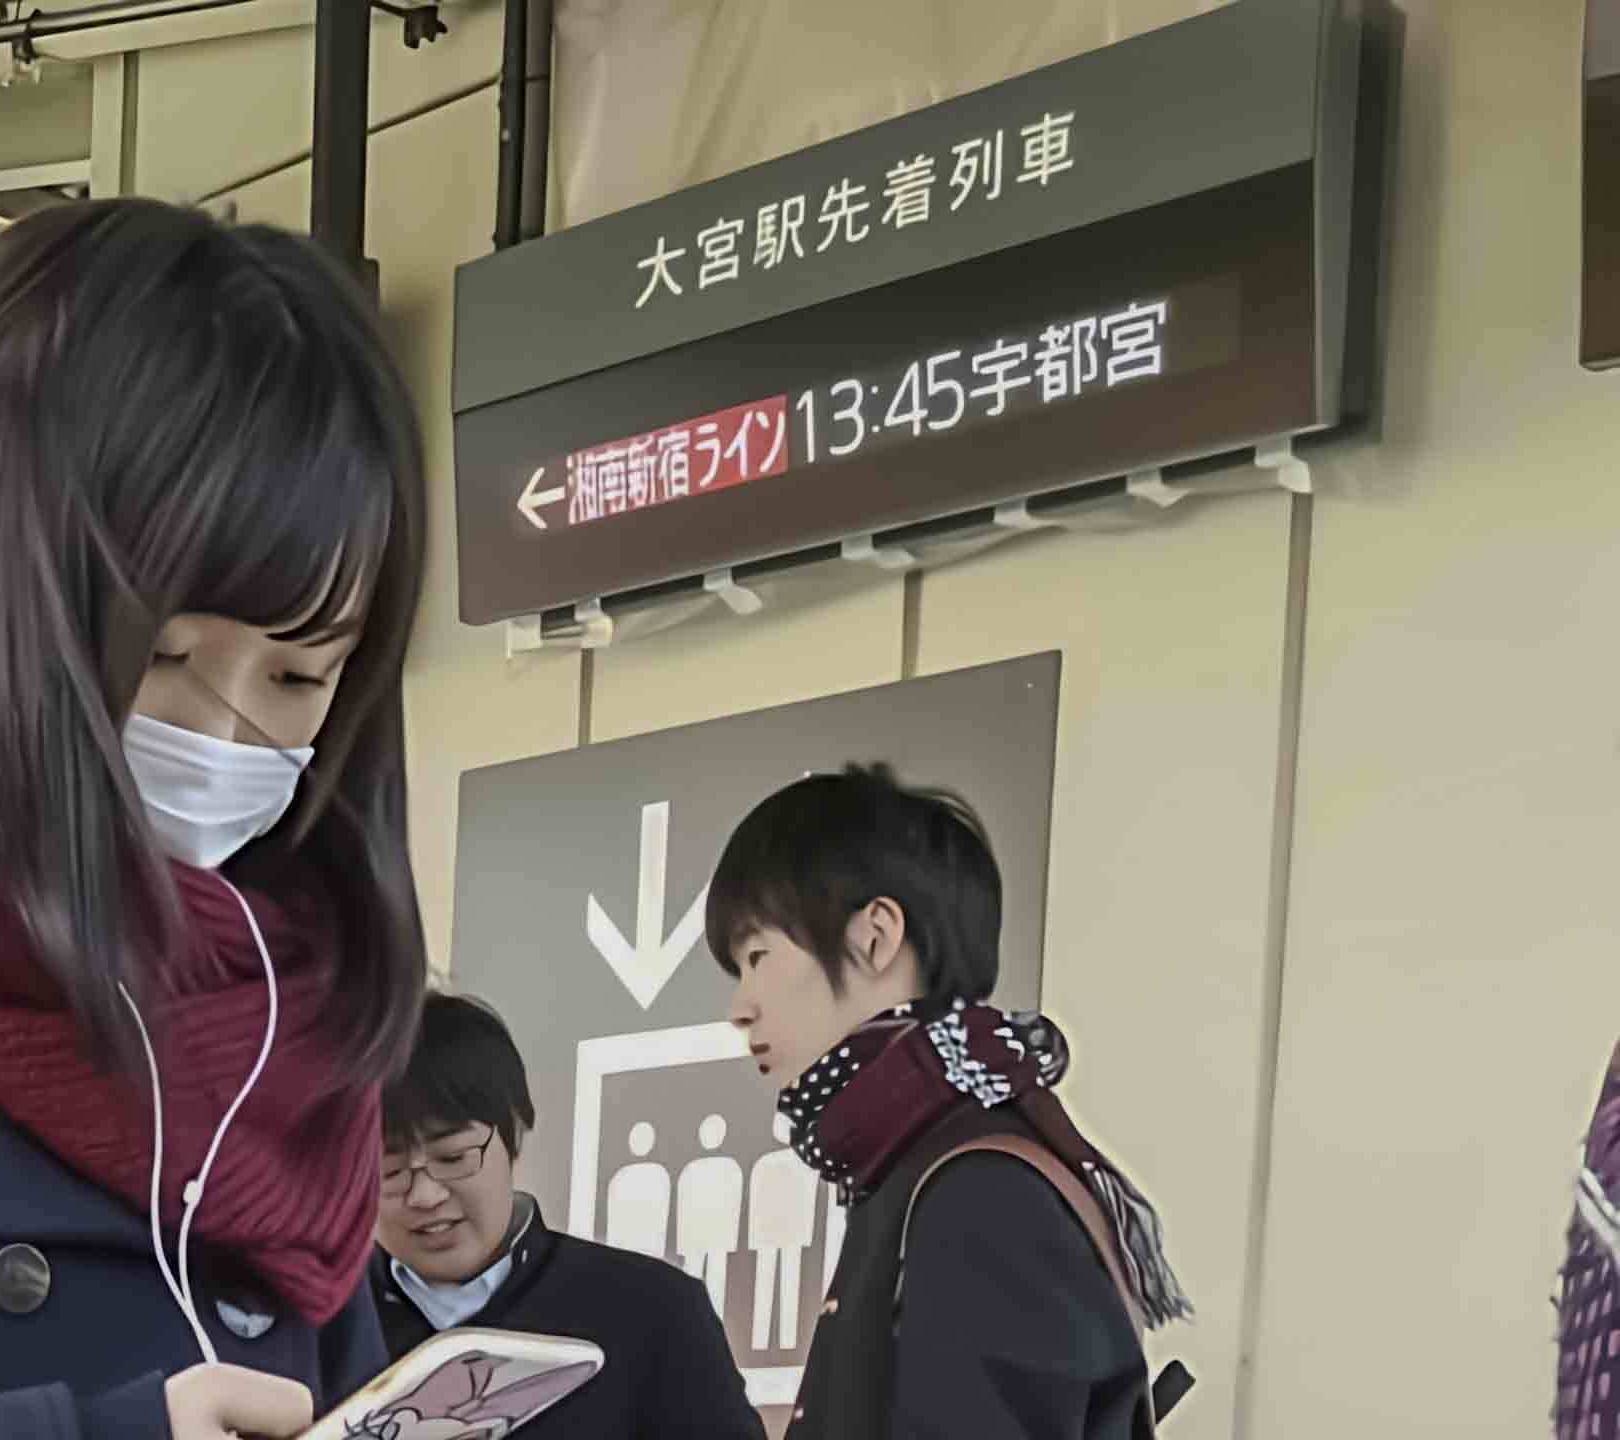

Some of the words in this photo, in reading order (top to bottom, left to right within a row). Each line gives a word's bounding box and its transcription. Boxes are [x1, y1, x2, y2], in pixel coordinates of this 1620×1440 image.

[635, 111, 1076, 308] 大宮駅先着列車
[566, 409, 785, 526] 湘南新宿ライン
